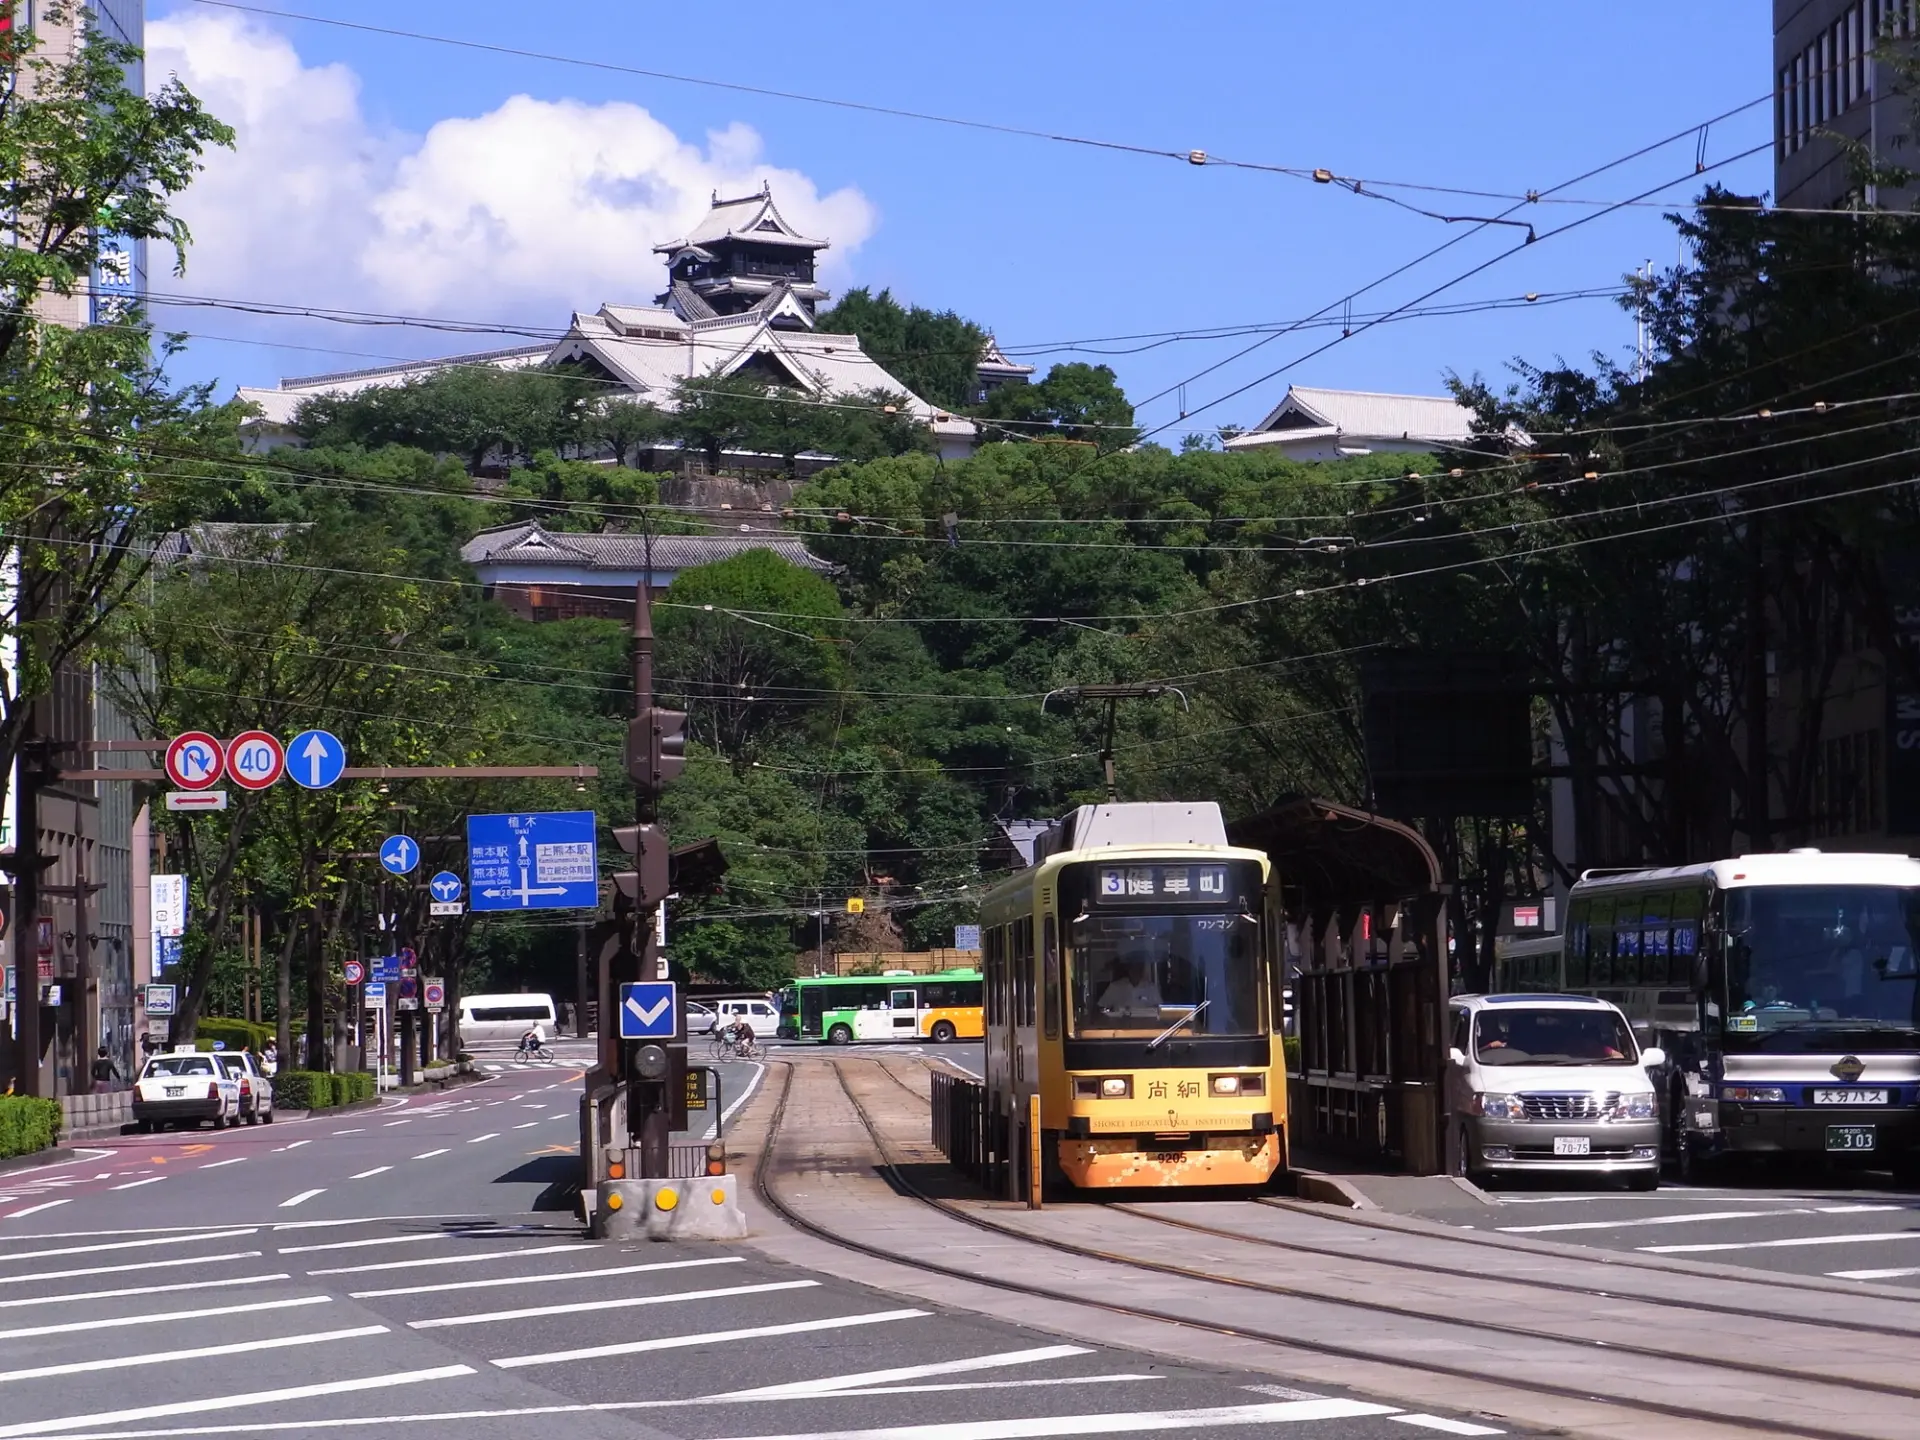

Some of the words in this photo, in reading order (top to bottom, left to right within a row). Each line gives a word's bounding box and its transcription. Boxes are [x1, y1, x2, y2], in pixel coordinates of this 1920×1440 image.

[240, 748, 270, 772] 40
[508, 816, 537, 828] 植木
[472, 846, 509, 858] 熊本駅
[541, 844, 589, 857] 上熊本駅
[473, 867, 510, 879] 熊本城
[1107, 871, 1120, 893] 3
[1126, 868, 1226, 895] 健軍町
[1198, 920, 1235, 929] ワンマン
[1821, 1089, 1882, 1103] 大分バス
[1561, 1143, 1588, 1154] 70-75
[1157, 1151, 1188, 1164] 9205
